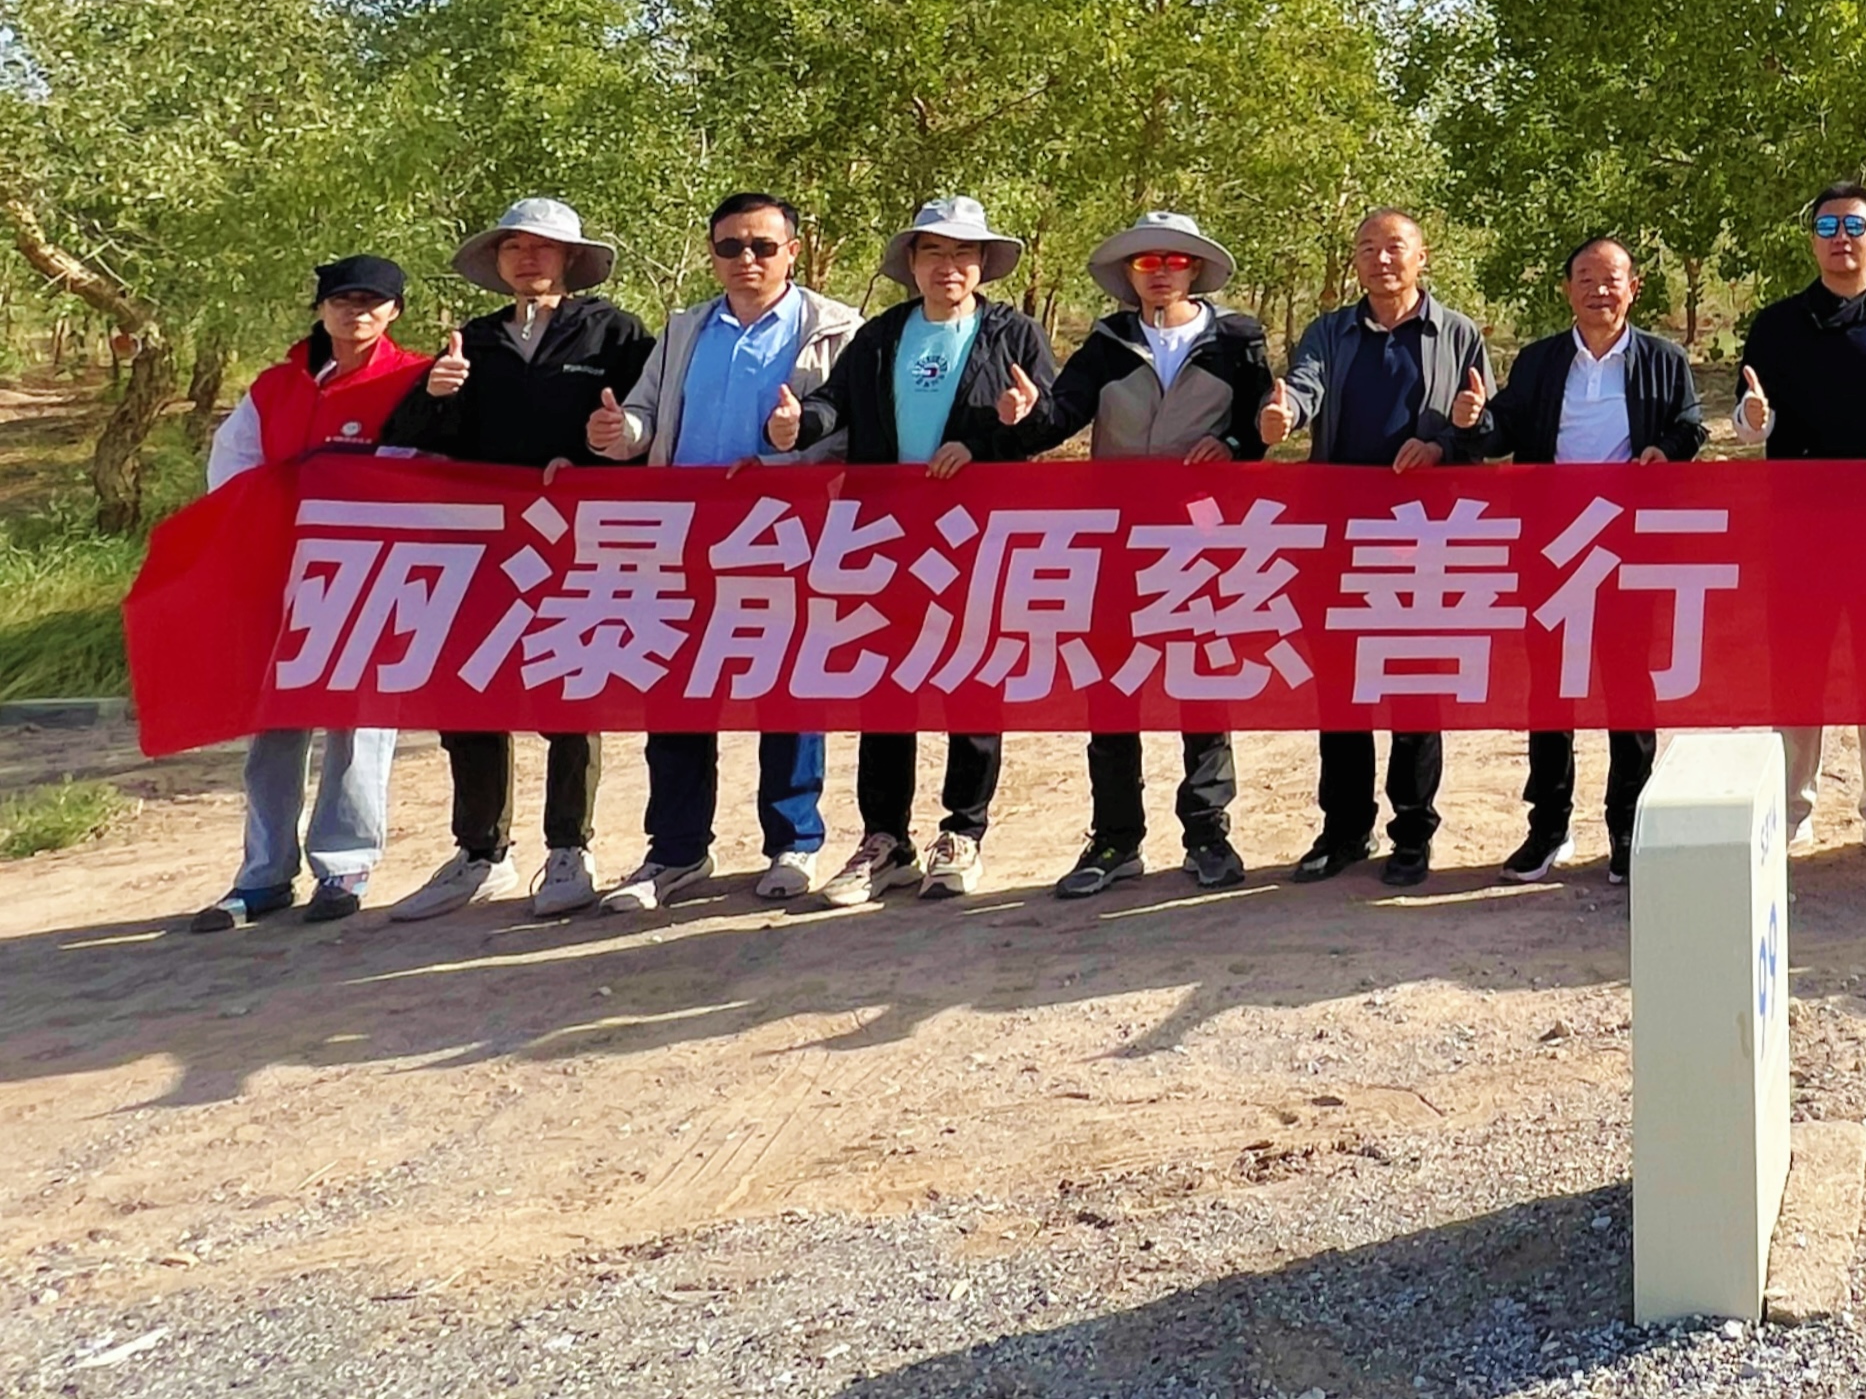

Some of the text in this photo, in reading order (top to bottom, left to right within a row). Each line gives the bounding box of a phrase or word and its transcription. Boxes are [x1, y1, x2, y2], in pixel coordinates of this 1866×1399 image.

[275, 496, 1739, 704] 丽瀑能源慈善行
